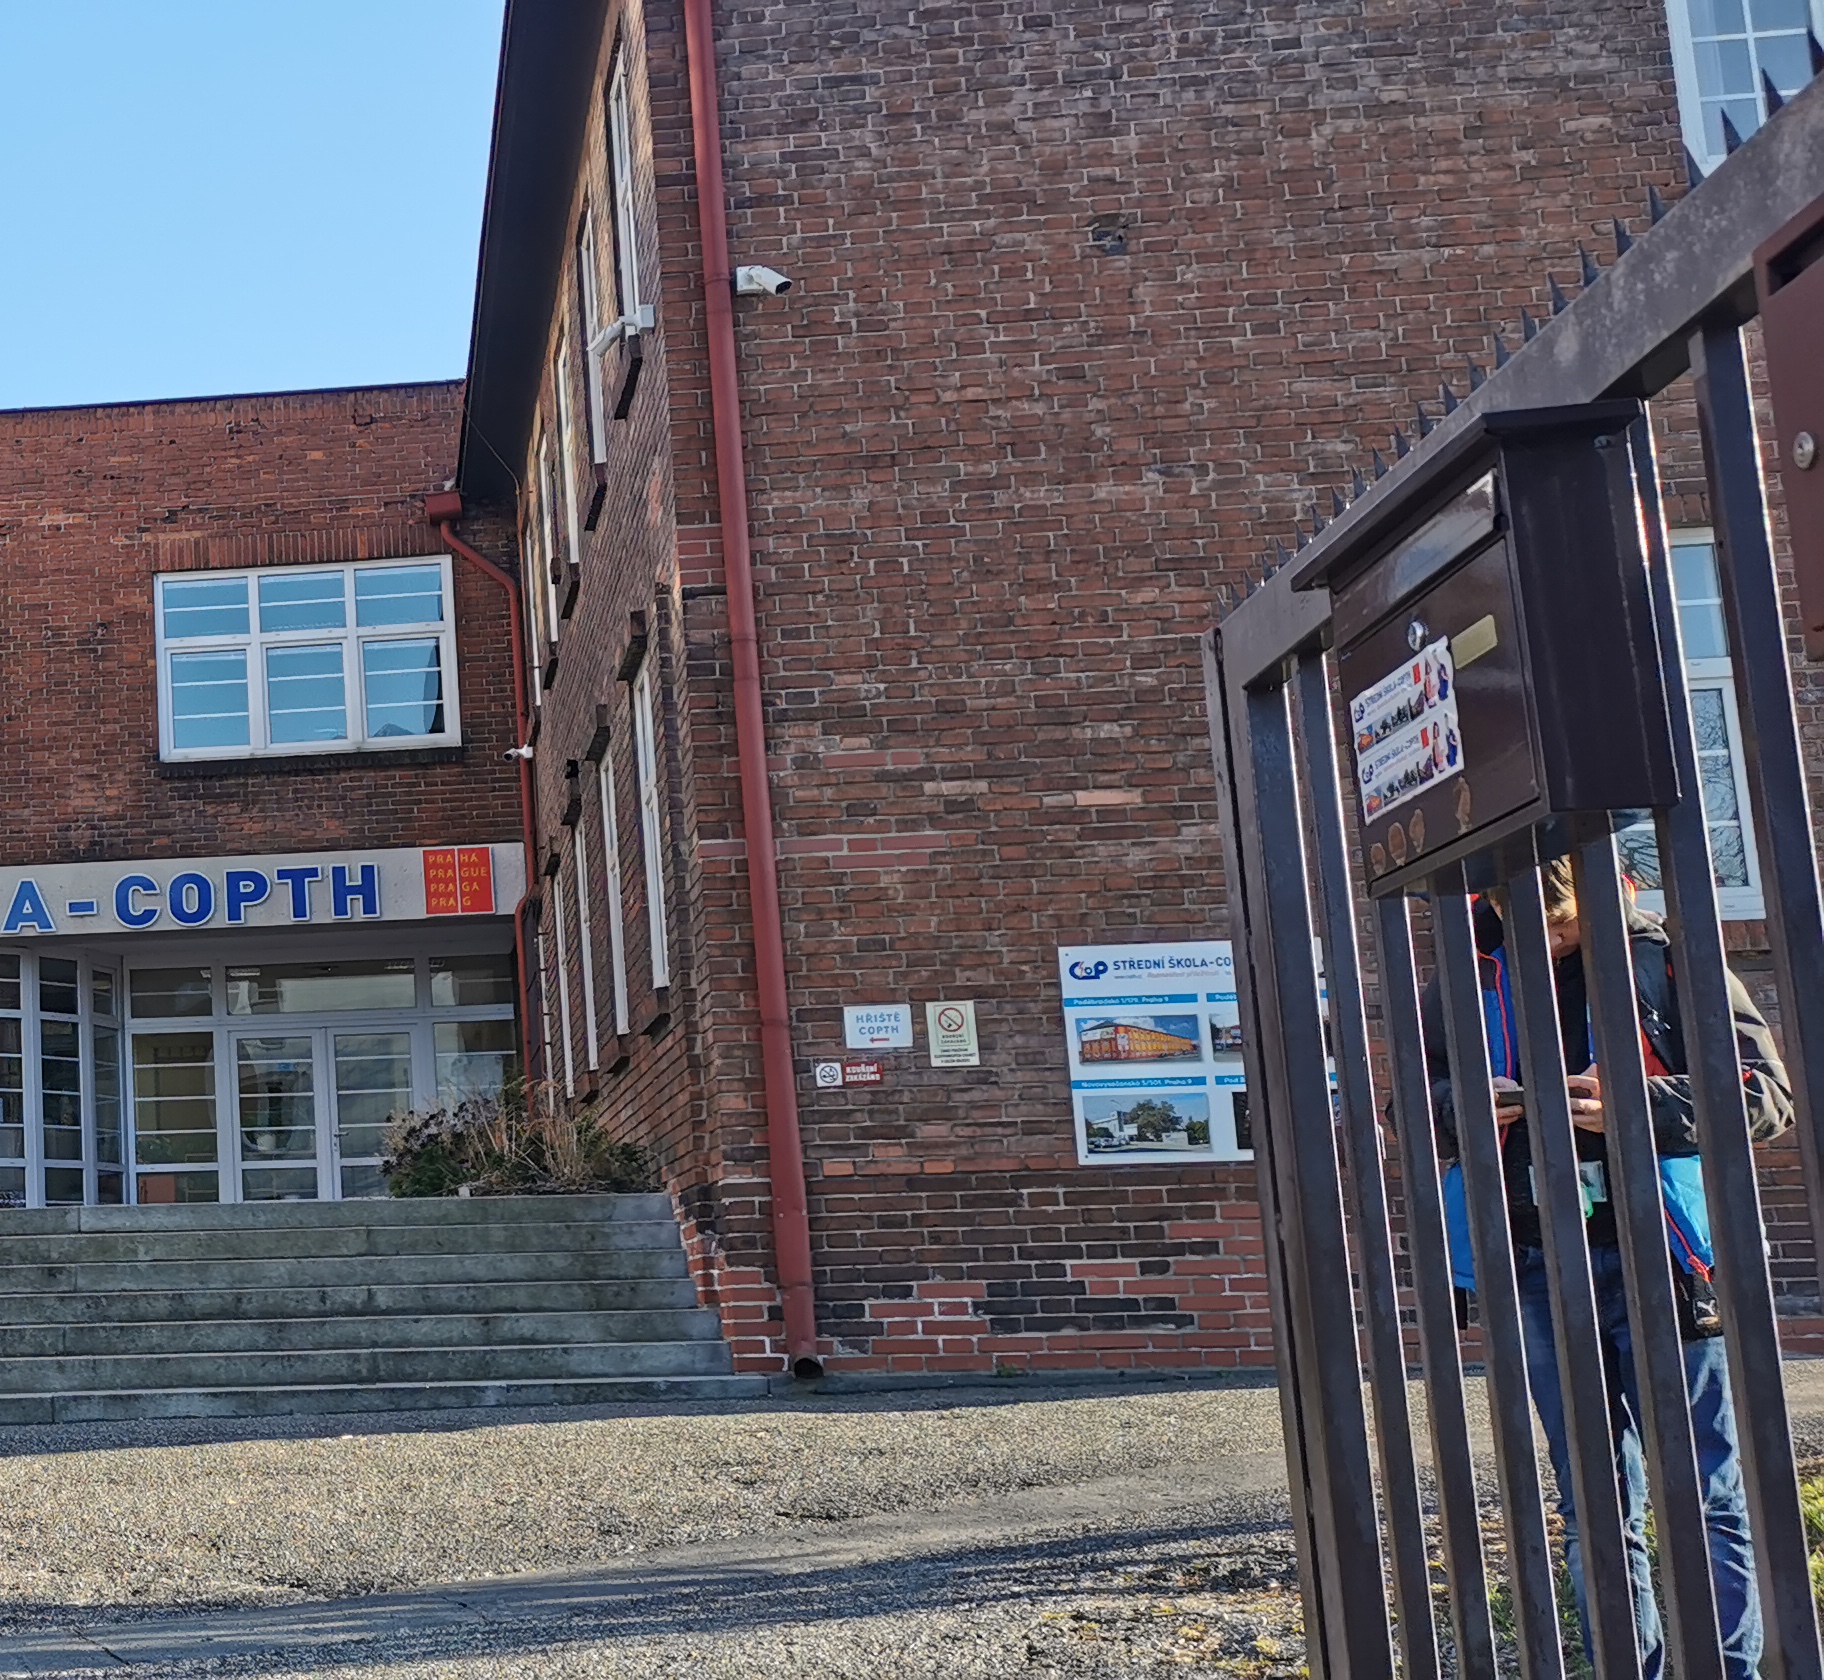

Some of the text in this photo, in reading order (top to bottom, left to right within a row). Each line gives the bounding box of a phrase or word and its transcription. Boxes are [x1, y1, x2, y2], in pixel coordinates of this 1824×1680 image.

[1113, 956, 1165, 971] STŘEDNÍ
[856, 1011, 901, 1024] HŘIŠTĚ
[858, 1025, 899, 1035] COPTH
